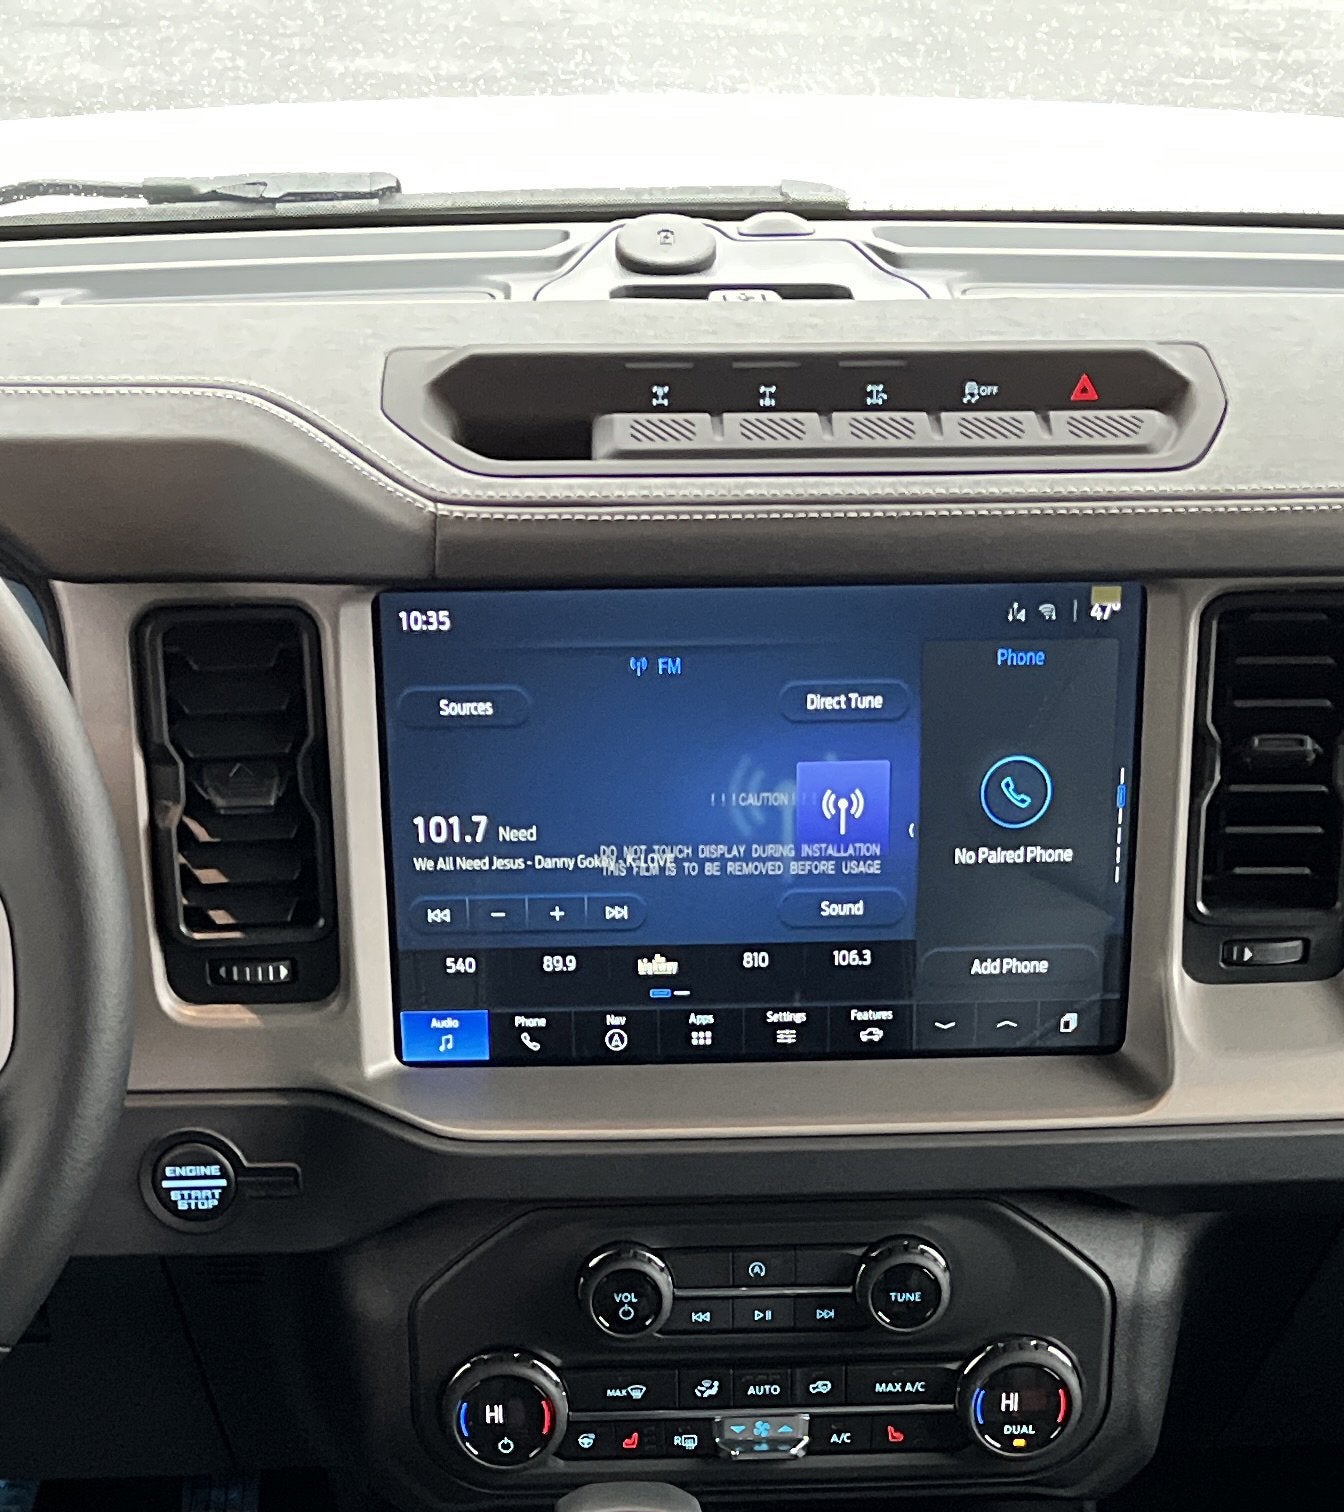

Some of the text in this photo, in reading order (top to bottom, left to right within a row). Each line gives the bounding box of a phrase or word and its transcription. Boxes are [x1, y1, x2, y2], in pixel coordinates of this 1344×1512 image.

[979, 385, 999, 396] OFF
[398, 609, 451, 631] 10:35
[996, 647, 1046, 667] Phone
[657, 656, 682, 675] FM
[439, 698, 494, 716] Sources
[805, 692, 884, 711] Direct Tune
[738, 792, 789, 807] CAUTION
[412, 815, 537, 844] 101.7 Need
[652, 843, 693, 859] TOUCH
[698, 843, 746, 859] DISPLAY
[751, 843, 795, 858] DURING
[800, 842, 882, 858] INSTALLATION
[954, 846, 1073, 865] No Paired Phone
[413, 857, 435, 871] We
[436, 856, 454, 871] All
[456, 856, 489, 870] Need
[490, 855, 525, 870] Jesus
[534, 855, 575, 871] Danny
[665, 862, 677, 876] IS
[683, 861, 699, 876] TO
[704, 861, 721, 876] BE
[726, 861, 784, 876] REMOVED
[789, 860, 836, 875] BEFORE
[841, 859, 882, 874] USAGE
[819, 899, 864, 917] Sound
[444, 956, 477, 974] 540
[541, 955, 577, 972] 89.9
[742, 951, 769, 968] 810
[832, 949, 872, 967] 106.3
[970, 957, 1049, 976] Add Phone
[514, 1015, 547, 1028] Phone
[605, 1014, 627, 1026] Nav
[688, 1013, 715, 1026] Apps
[766, 1010, 807, 1024] Settings
[850, 1008, 893, 1022] Features
[430, 1017, 460, 1030] Audio
[164, 1164, 222, 1177] ENGINE
[170, 1189, 222, 1201] START
[177, 1200, 219, 1211] STOP
[613, 1292, 638, 1303] VOL
[889, 1291, 922, 1303] TUNE
[606, 1387, 628, 1397] MAX
[747, 1384, 781, 1396] AUTO
[875, 1381, 926, 1393] MAX A/C
[1000, 1392, 1019, 1412] HI
[485, 1404, 504, 1424] HI
[1003, 1424, 1036, 1435] DUAL
[830, 1431, 851, 1444] A/C
